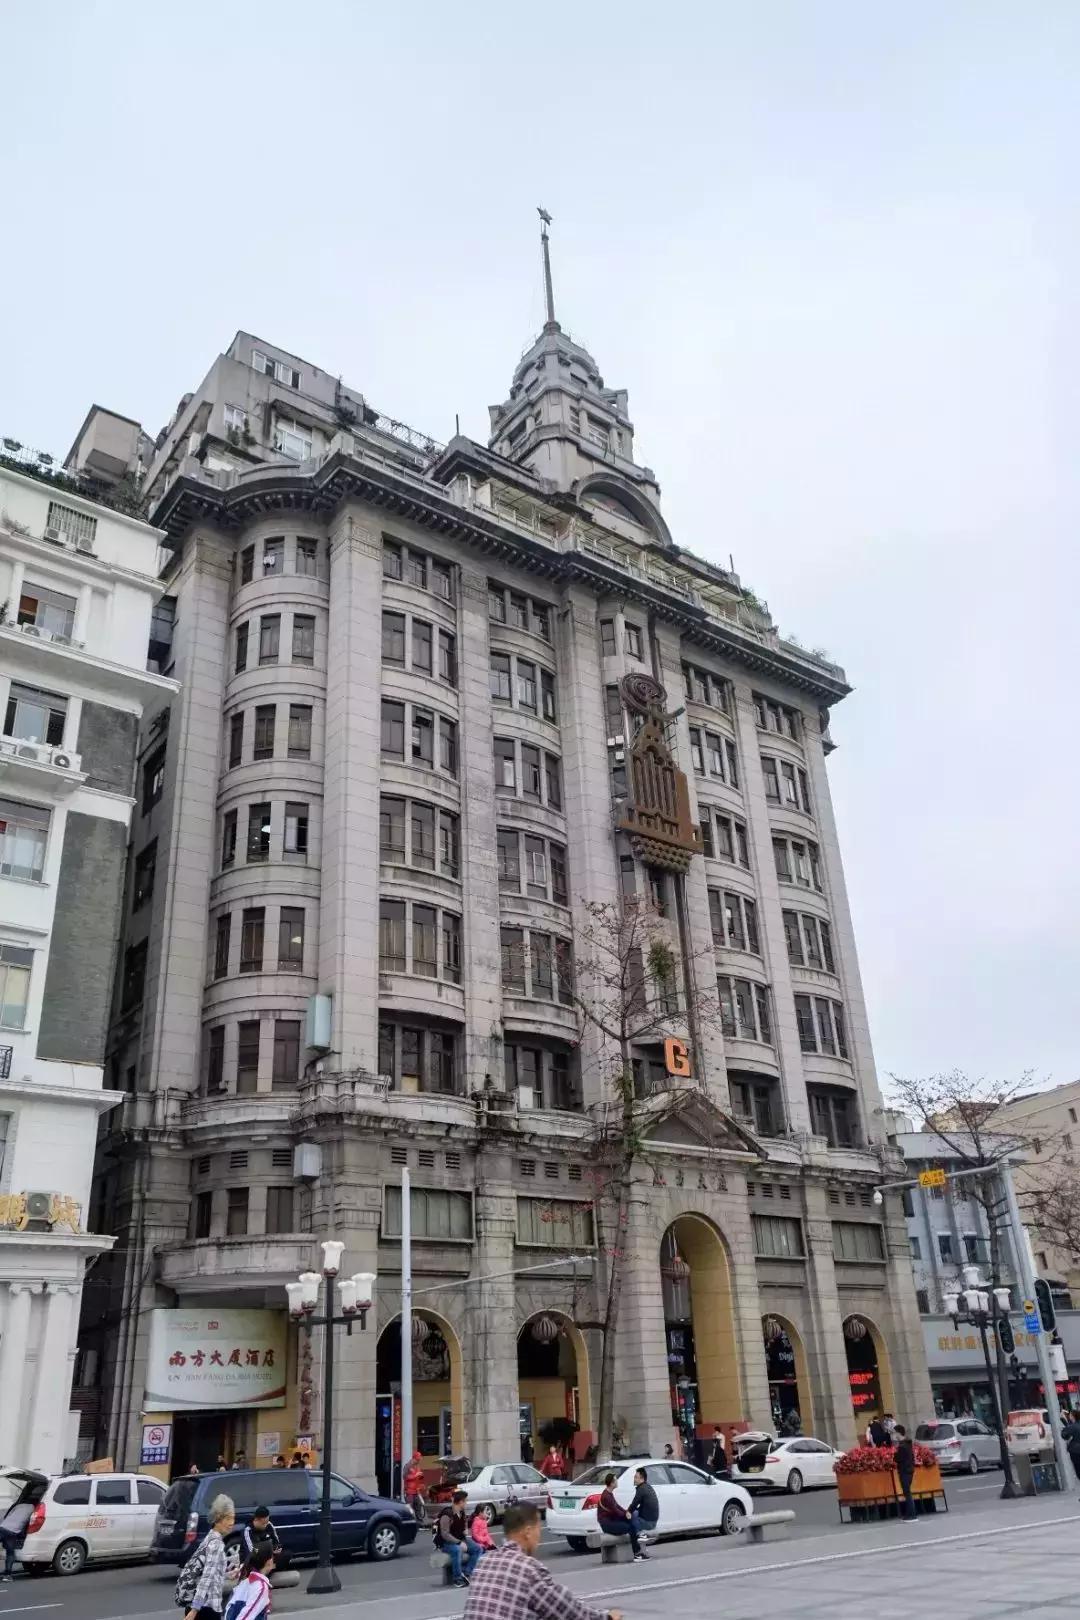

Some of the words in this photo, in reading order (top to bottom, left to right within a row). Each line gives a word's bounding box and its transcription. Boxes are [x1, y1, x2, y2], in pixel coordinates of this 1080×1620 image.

[168, 1348, 275, 1368] 南方大厦酒店
